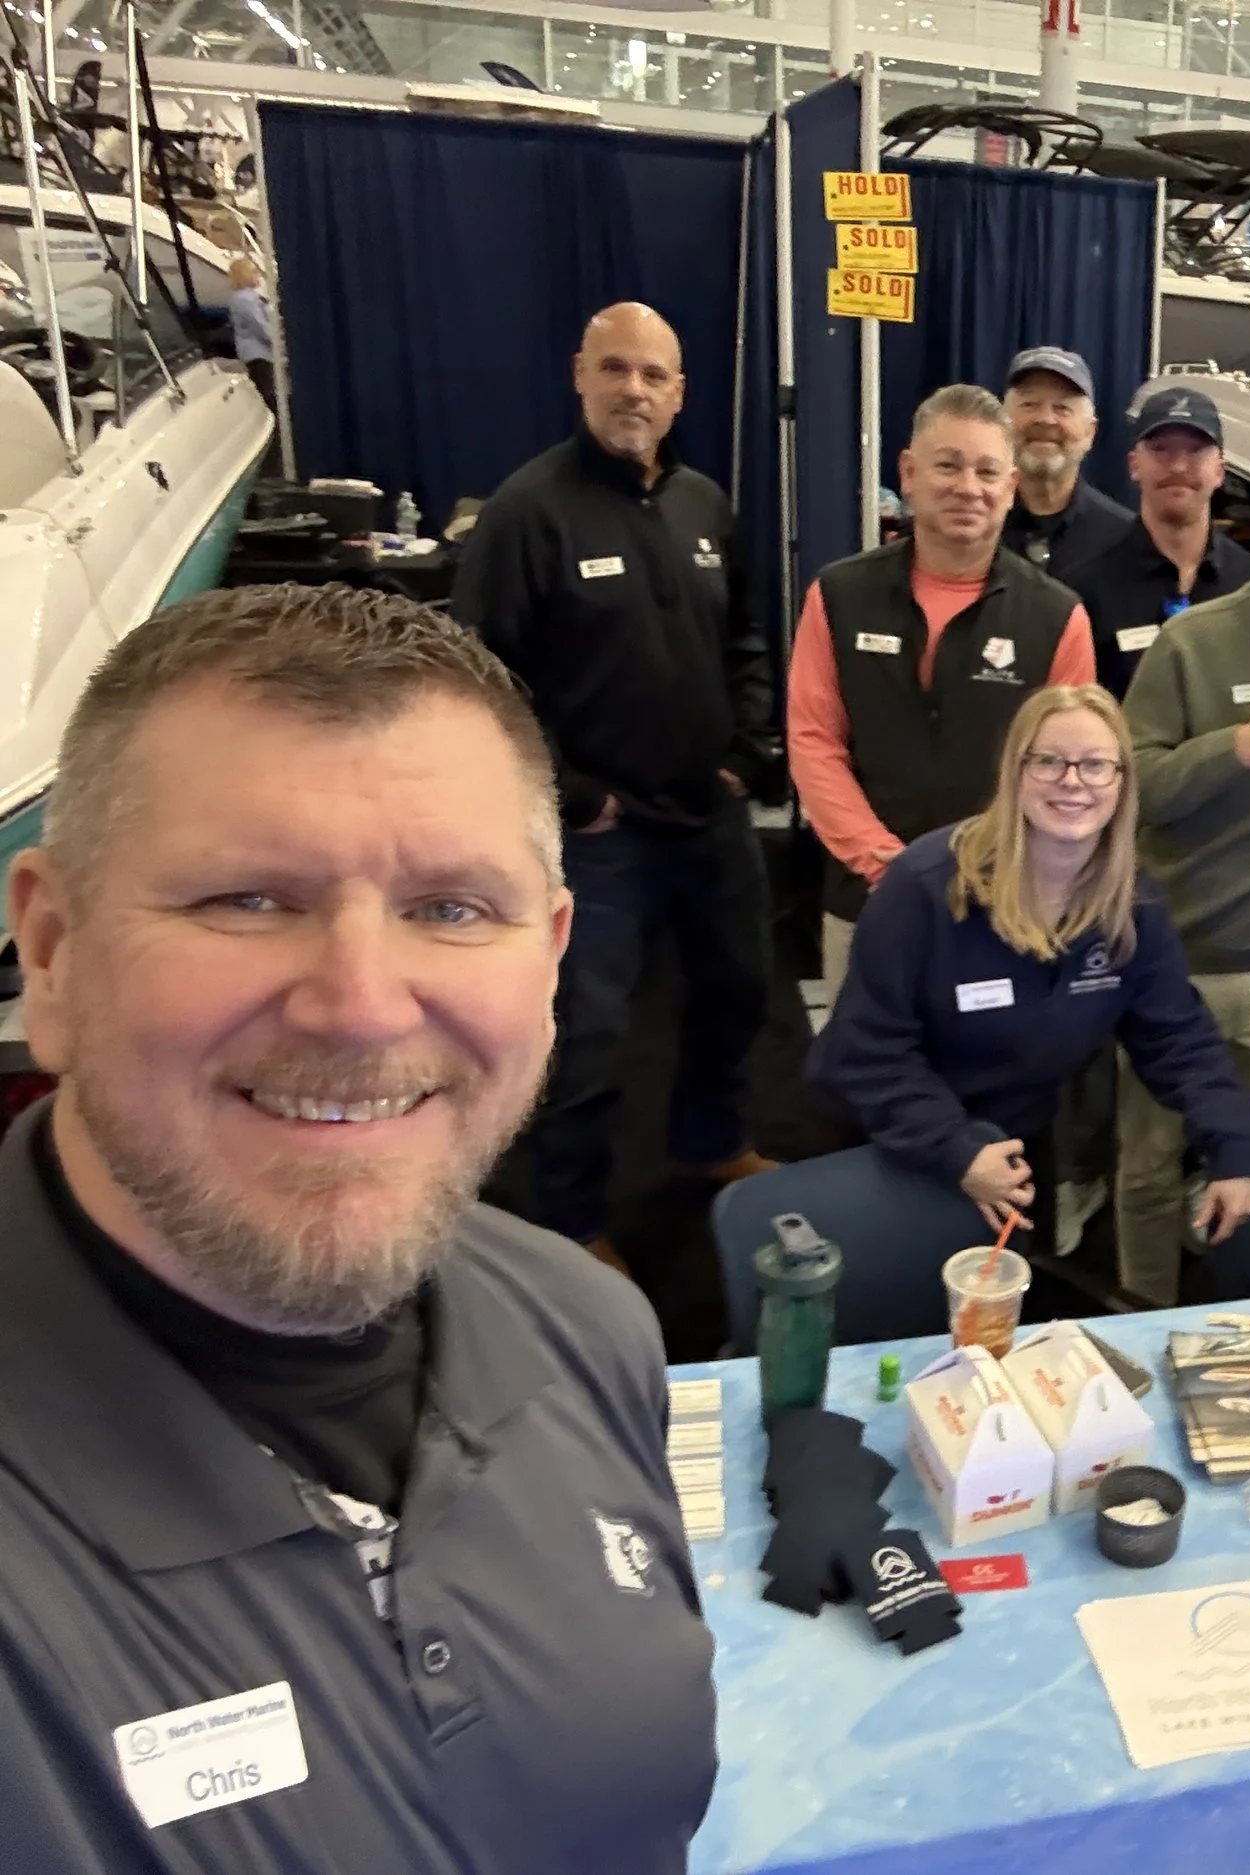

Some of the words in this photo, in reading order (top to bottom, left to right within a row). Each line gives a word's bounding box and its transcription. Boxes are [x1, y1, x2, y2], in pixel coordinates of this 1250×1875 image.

[837, 174, 898, 196] HOLD
[850, 227, 906, 249] SOLD
[842, 272, 903, 297] SOLD
[167, 1717, 207, 1740] North
[207, 1709, 245, 1729] Water
[186, 1759, 262, 1802] Chris
